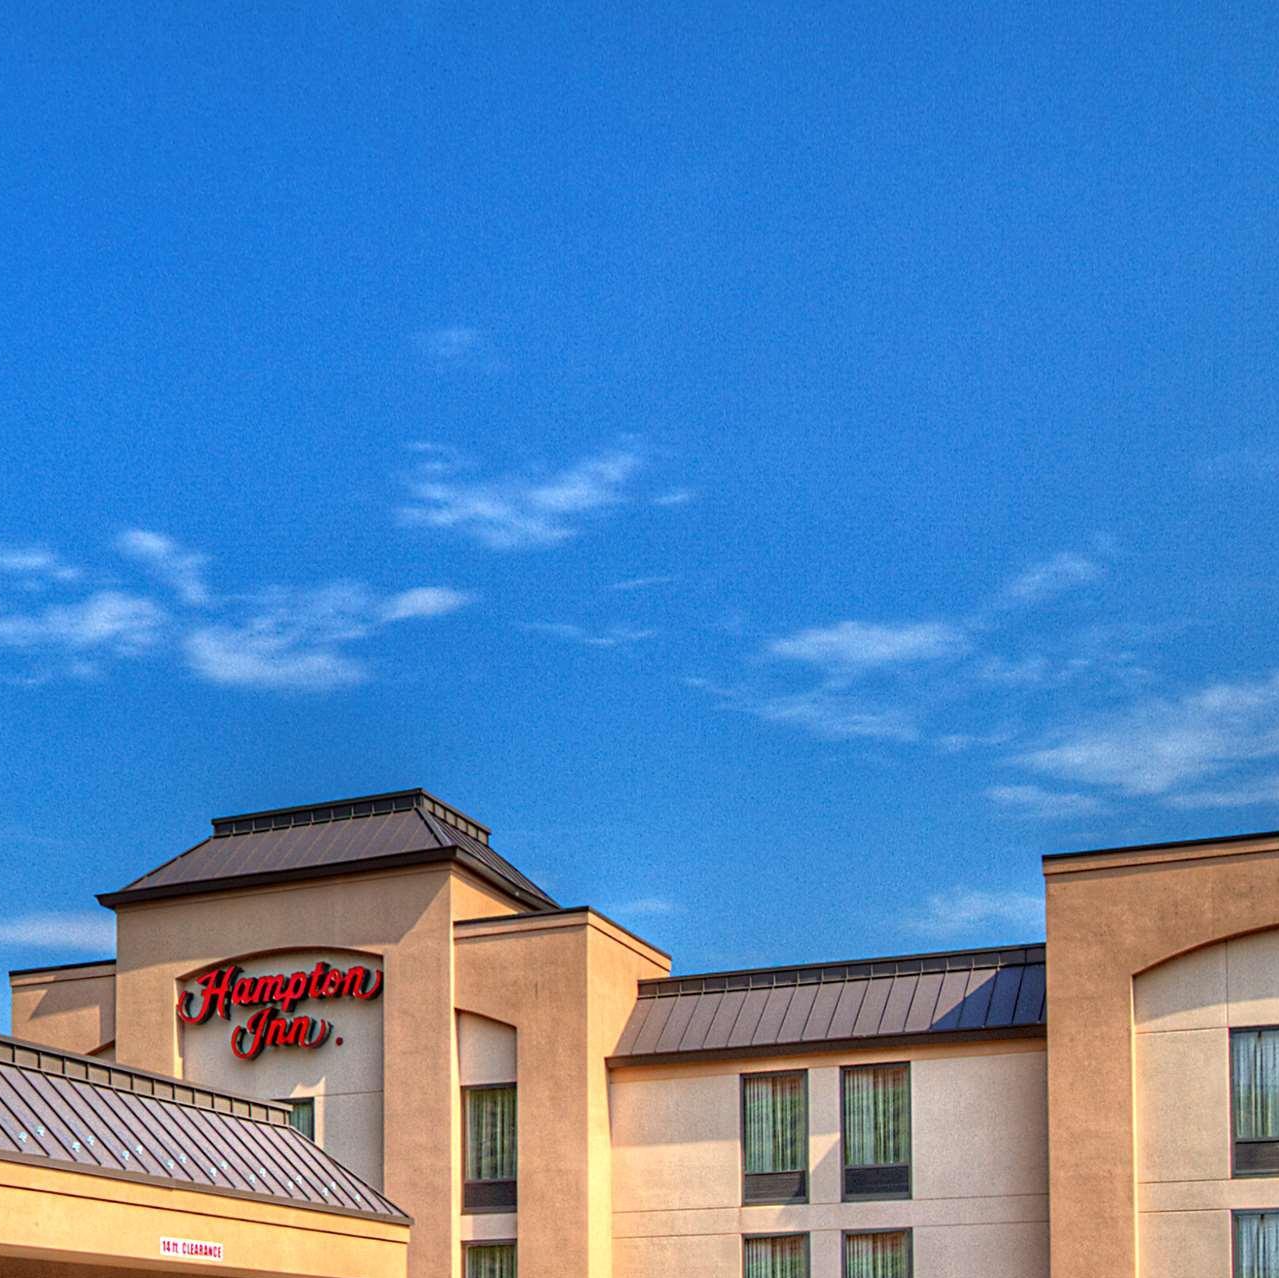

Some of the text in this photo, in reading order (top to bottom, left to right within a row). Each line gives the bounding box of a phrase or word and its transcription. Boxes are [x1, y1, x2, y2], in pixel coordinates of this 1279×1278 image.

[176, 961, 383, 1024] Hampton
[231, 1006, 332, 1060] Inn
[182, 1241, 221, 1259] CLEARANCE
